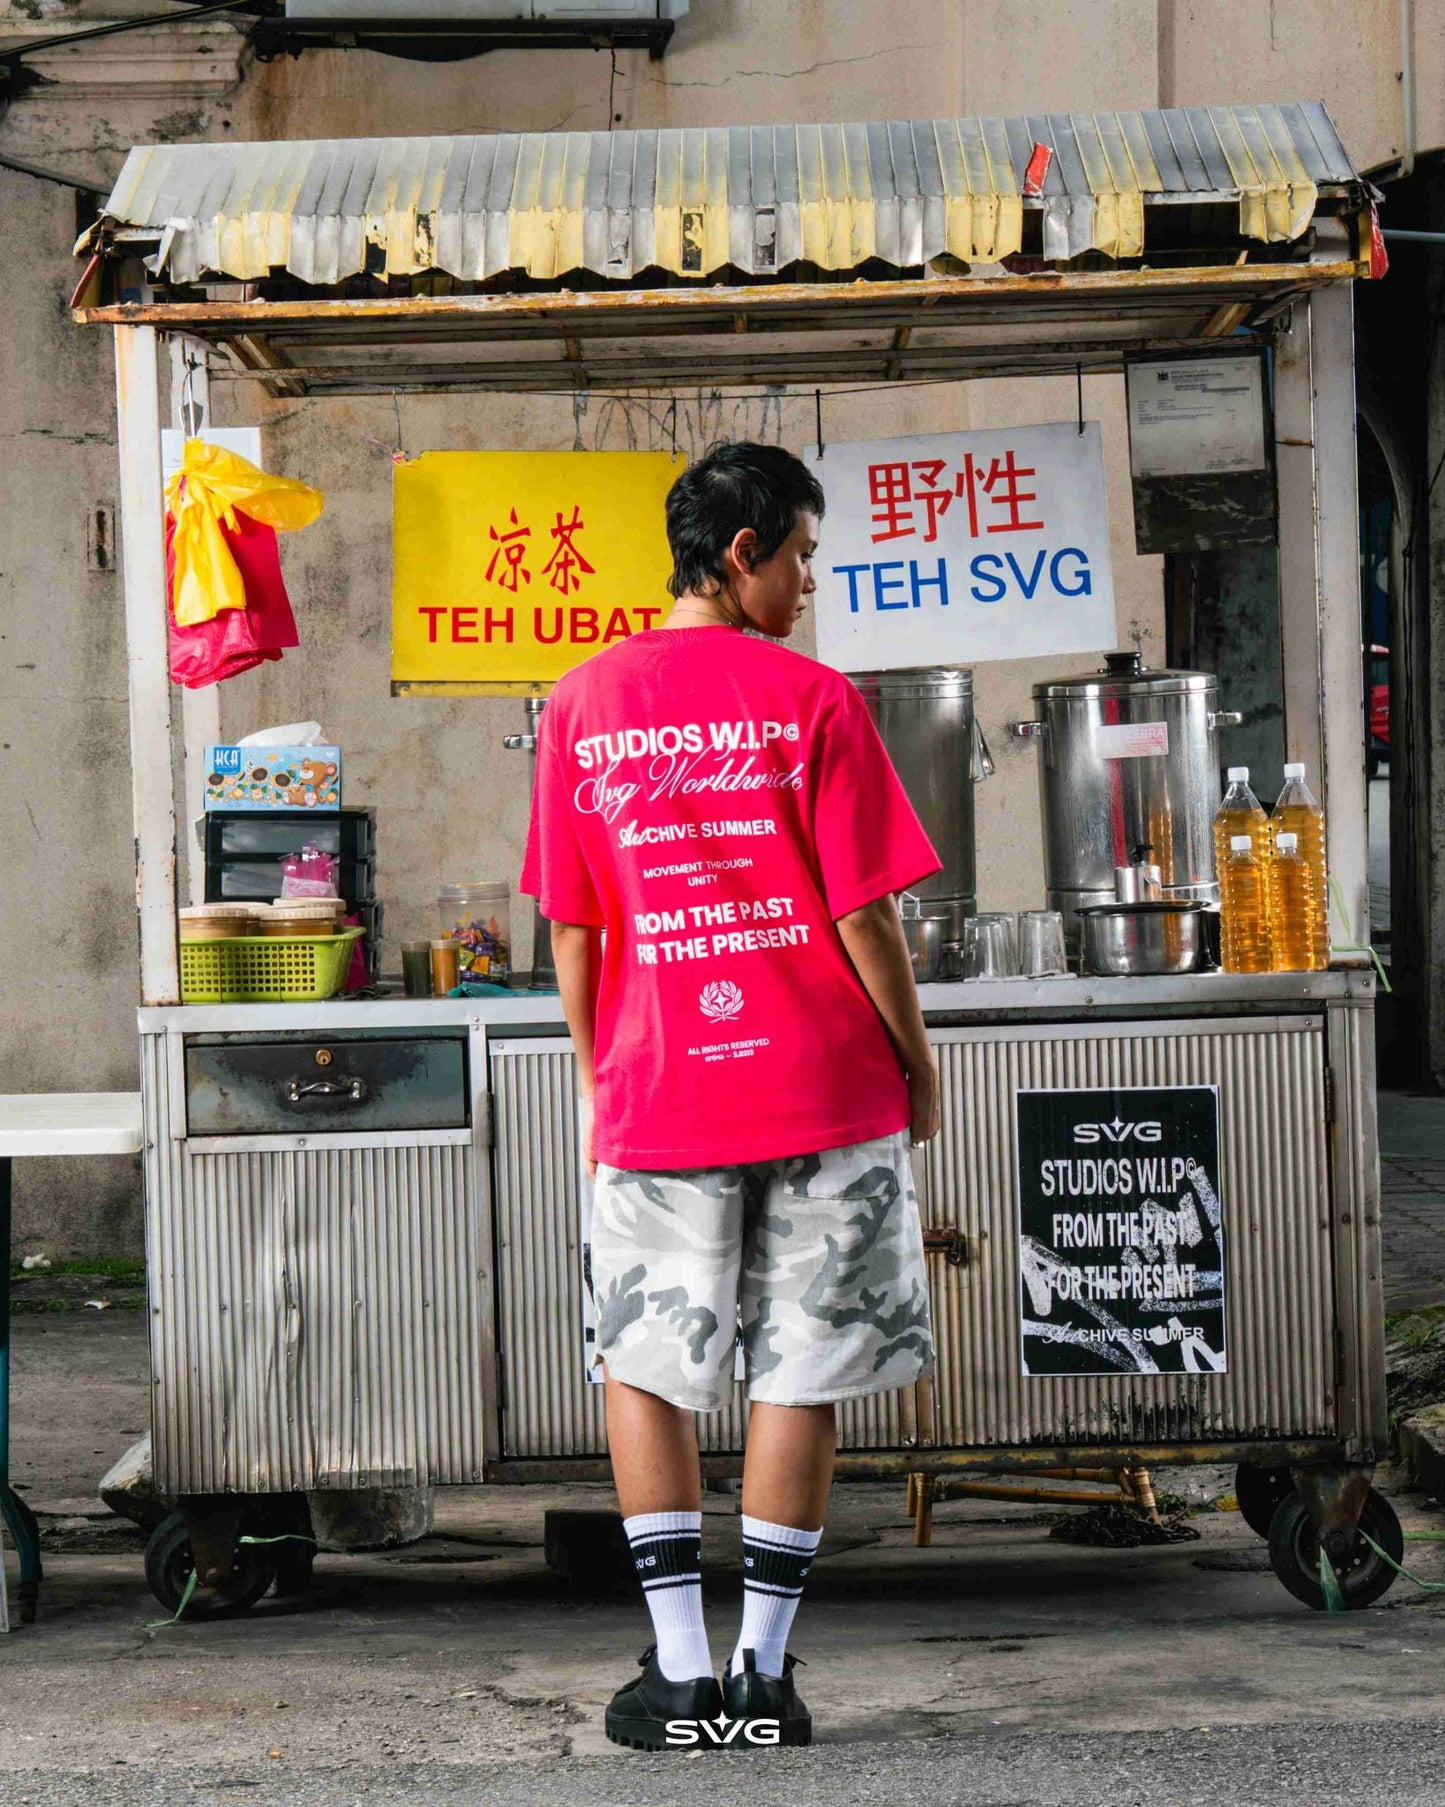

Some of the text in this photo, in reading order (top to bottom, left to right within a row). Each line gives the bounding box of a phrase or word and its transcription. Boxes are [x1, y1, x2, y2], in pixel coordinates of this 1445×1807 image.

[868, 450, 1044, 544] 野性
[484, 505, 596, 595] 凉茶
[832, 547, 1092, 613] TEH SVG
[418, 607, 661, 644] TEH UBAT
[574, 724, 703, 768] STUDIOS
[648, 740, 804, 801] Worldwide
[701, 819, 777, 838] SUMMER
[643, 857, 753, 879] MOVEMENT THROUGH
[687, 873, 718, 887] UNITY
[688, 902, 737, 927] THE
[739, 897, 793, 921] PAST
[660, 938, 709, 963] THE
[711, 924, 809, 956] PRESENT
[687, 1047, 701, 1056] ALL
[701, 1043, 730, 1054] RIGHTS
[730, 1038, 770, 1050] RESERVED
[1073, 1118, 1162, 1143] SVG
[1041, 1158, 1133, 1196] STUDIOS
[1053, 1211, 1187, 1248] FROM THE PAST
[1084, 1265, 1118, 1299] THE
[1121, 1264, 1196, 1299] PRESENT
